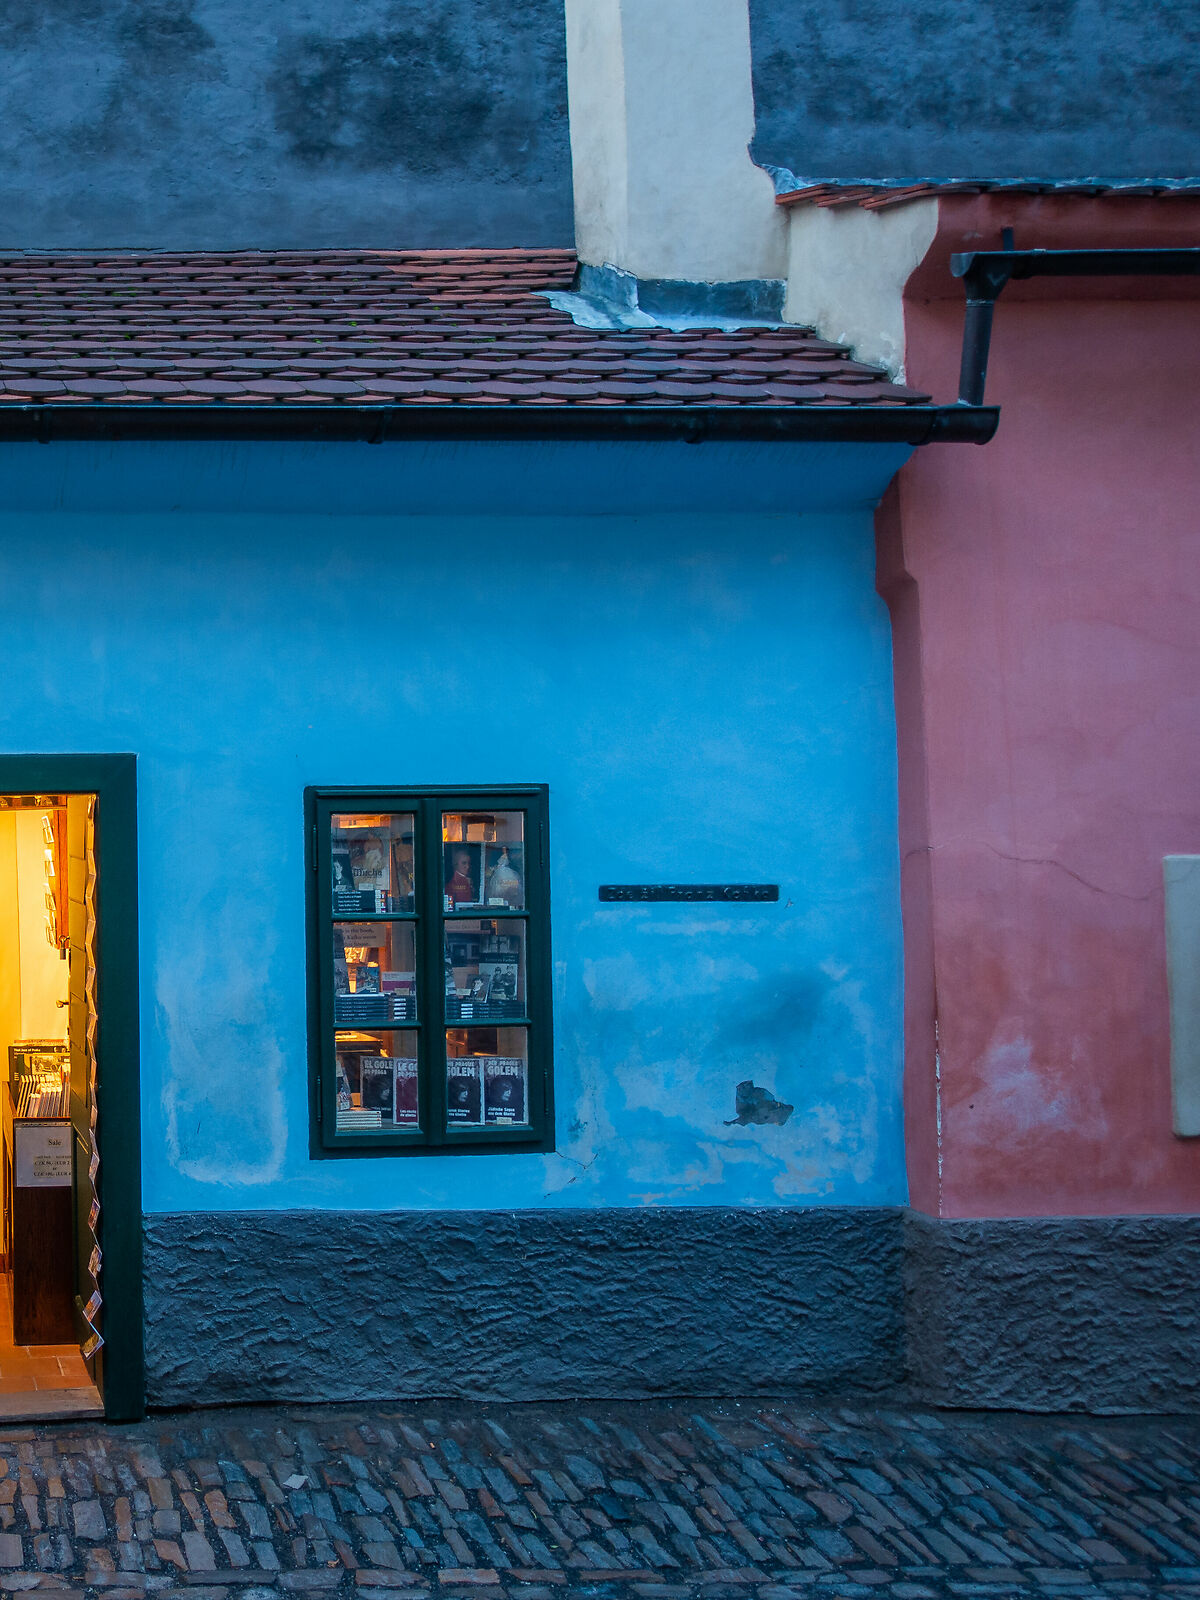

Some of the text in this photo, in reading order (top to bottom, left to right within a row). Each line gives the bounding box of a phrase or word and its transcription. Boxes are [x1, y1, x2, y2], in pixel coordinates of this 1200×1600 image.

[353, 868, 382, 878] Mucha
[374, 1060, 393, 1069] GOLE
[487, 1066, 518, 1076] GOLEM
